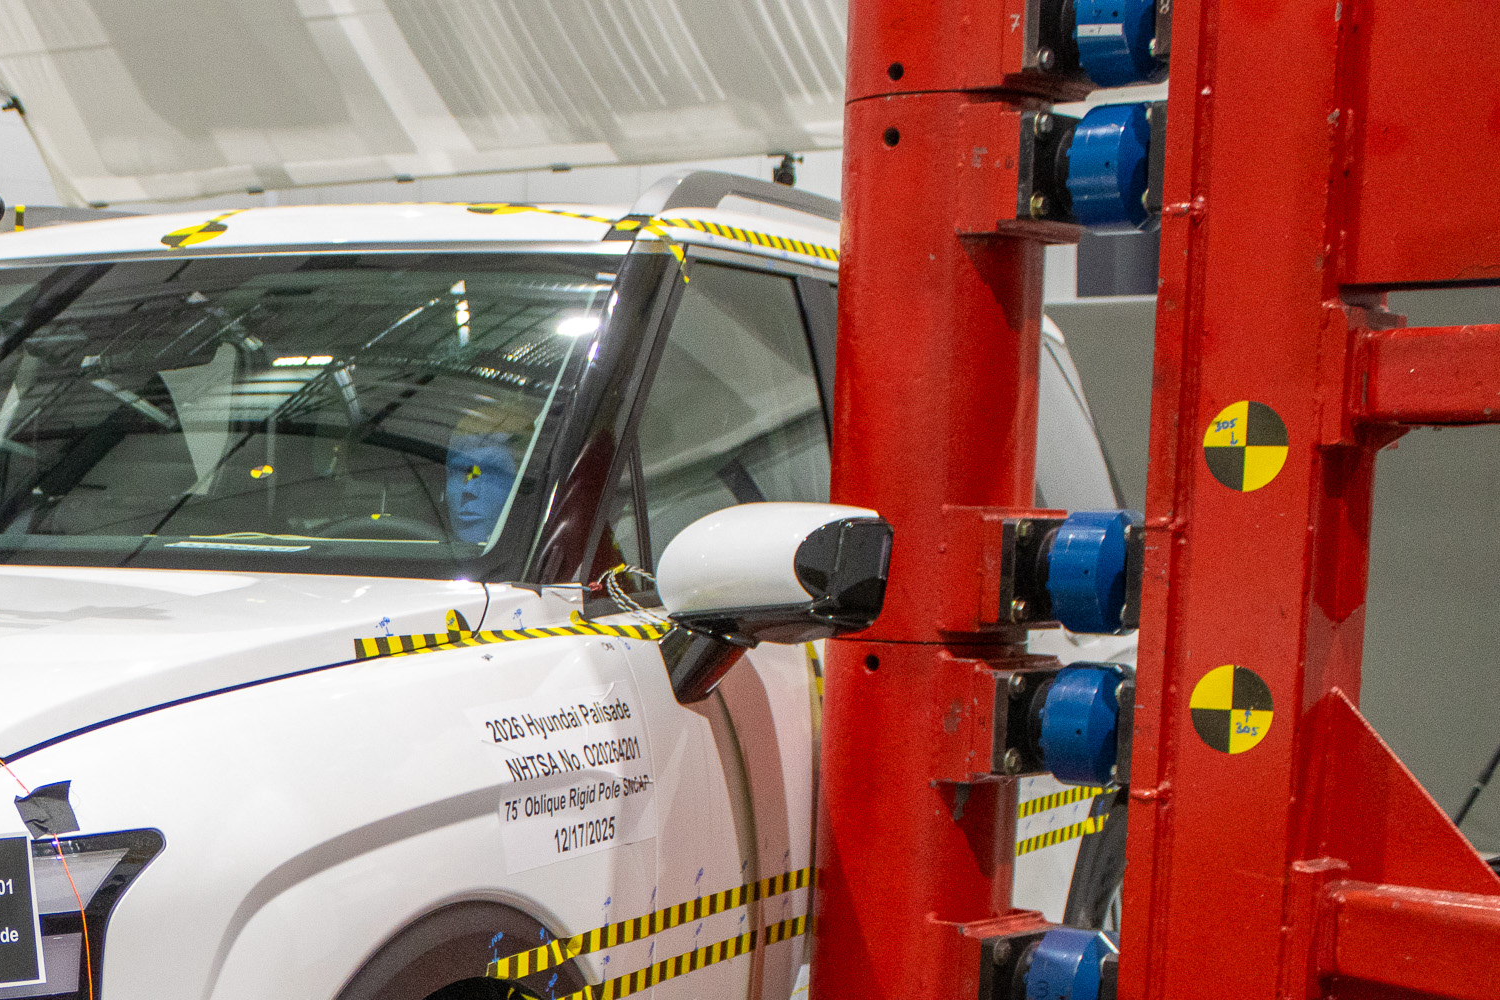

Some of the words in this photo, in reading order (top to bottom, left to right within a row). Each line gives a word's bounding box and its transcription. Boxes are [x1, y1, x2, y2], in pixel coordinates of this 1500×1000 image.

[486, 716, 526, 743] 2026
[522, 706, 582, 740] Hyundai
[579, 698, 631, 723] Palisade
[505, 752, 562, 782] NHTSA
[558, 749, 585, 772] No.
[525, 794, 566, 817] Oblique
[569, 784, 596, 810] Rigid
[599, 781, 620, 800] Pole
[554, 816, 616, 853] 12/17/2025
